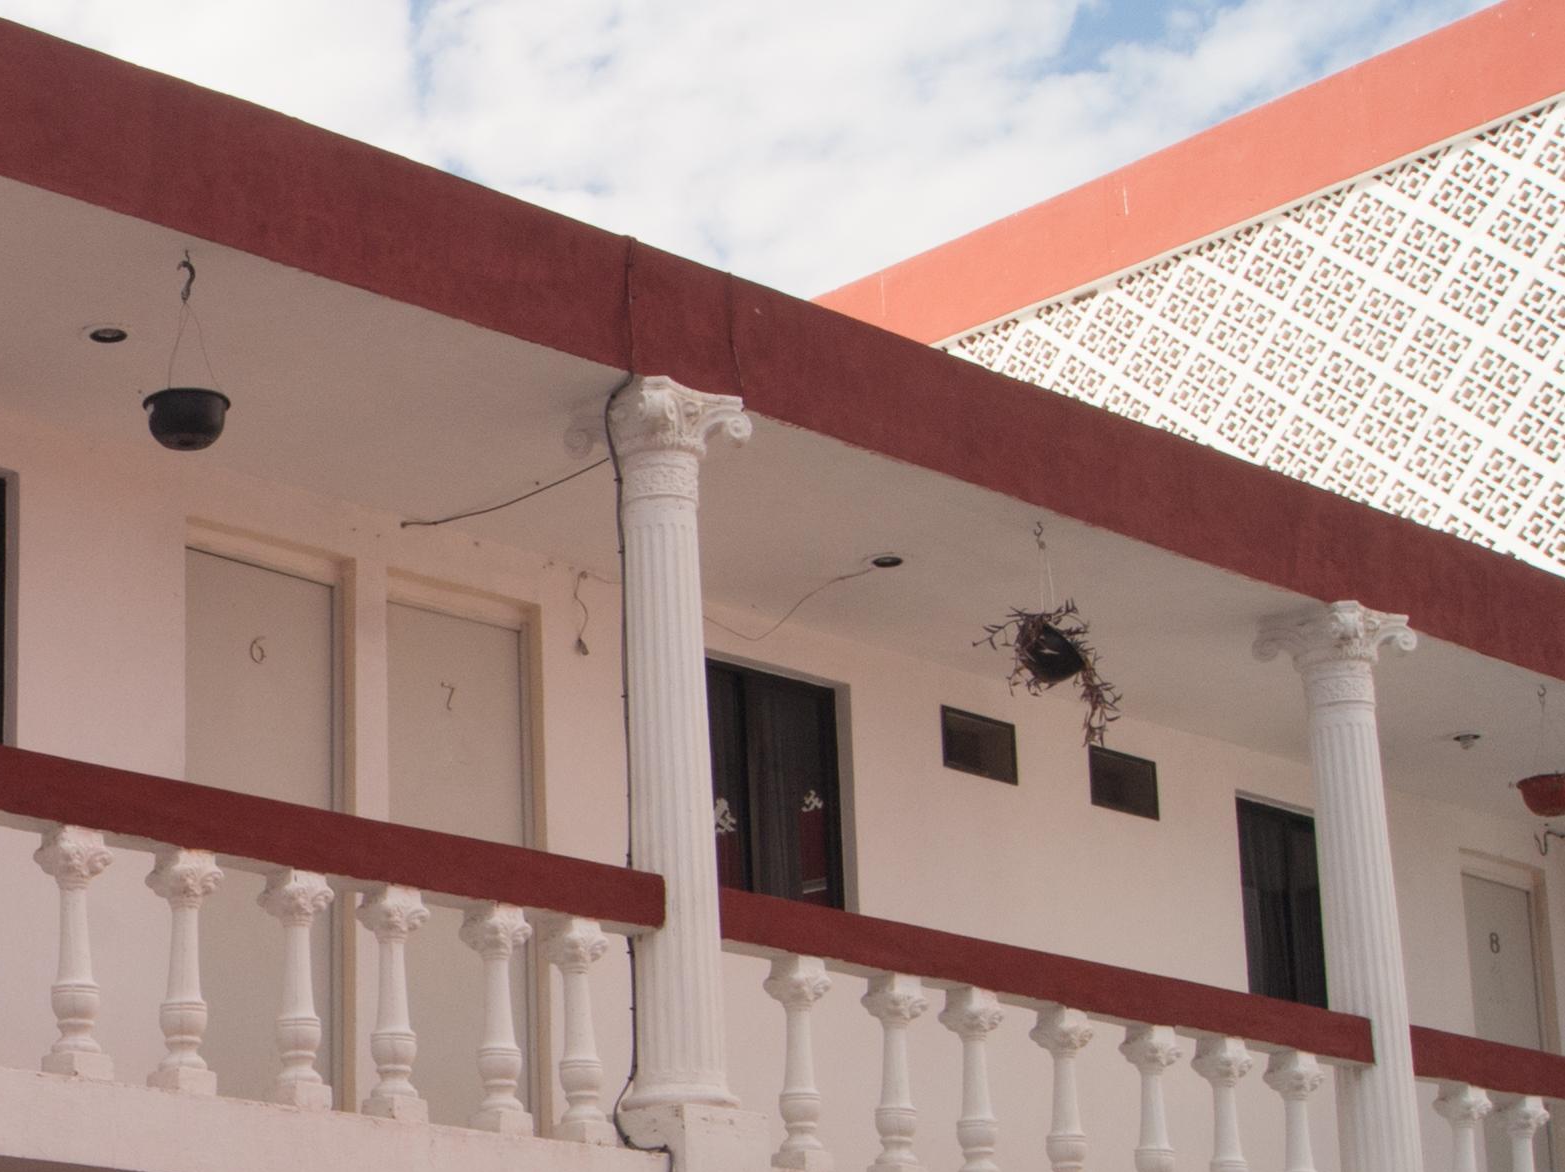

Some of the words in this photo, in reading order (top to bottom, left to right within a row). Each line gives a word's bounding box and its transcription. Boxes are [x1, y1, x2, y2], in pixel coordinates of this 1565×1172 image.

[249, 635, 267, 665] 6
[440, 682, 456, 711] 7
[1488, 932, 1501, 955] 8
